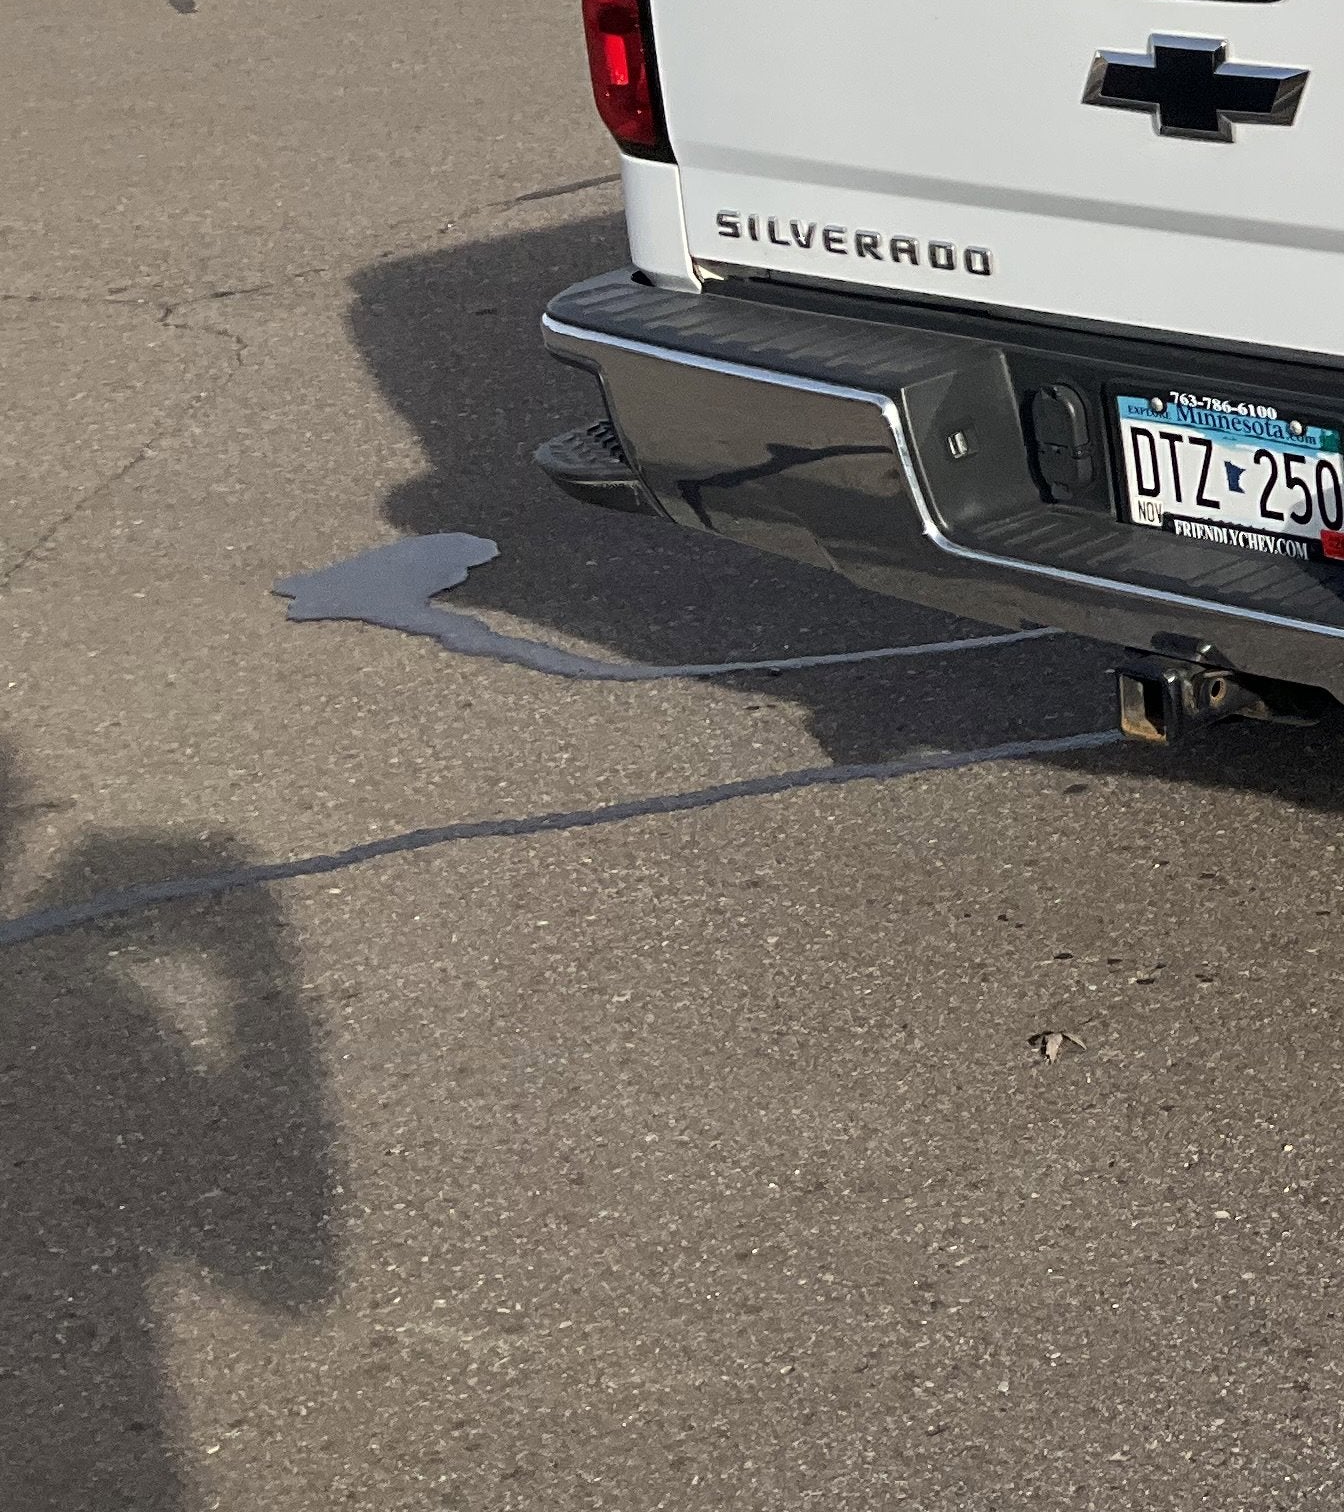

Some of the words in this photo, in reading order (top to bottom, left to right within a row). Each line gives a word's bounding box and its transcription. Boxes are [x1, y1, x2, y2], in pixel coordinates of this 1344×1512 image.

[715, 209, 994, 276] SILVERADO
[1169, 391, 1278, 420] 763-786-6100
[1130, 426, 1220, 510] DTZ
[1253, 448, 1343, 531] 250
[1173, 519, 1309, 561] FRIENDLYCHEV.COM
